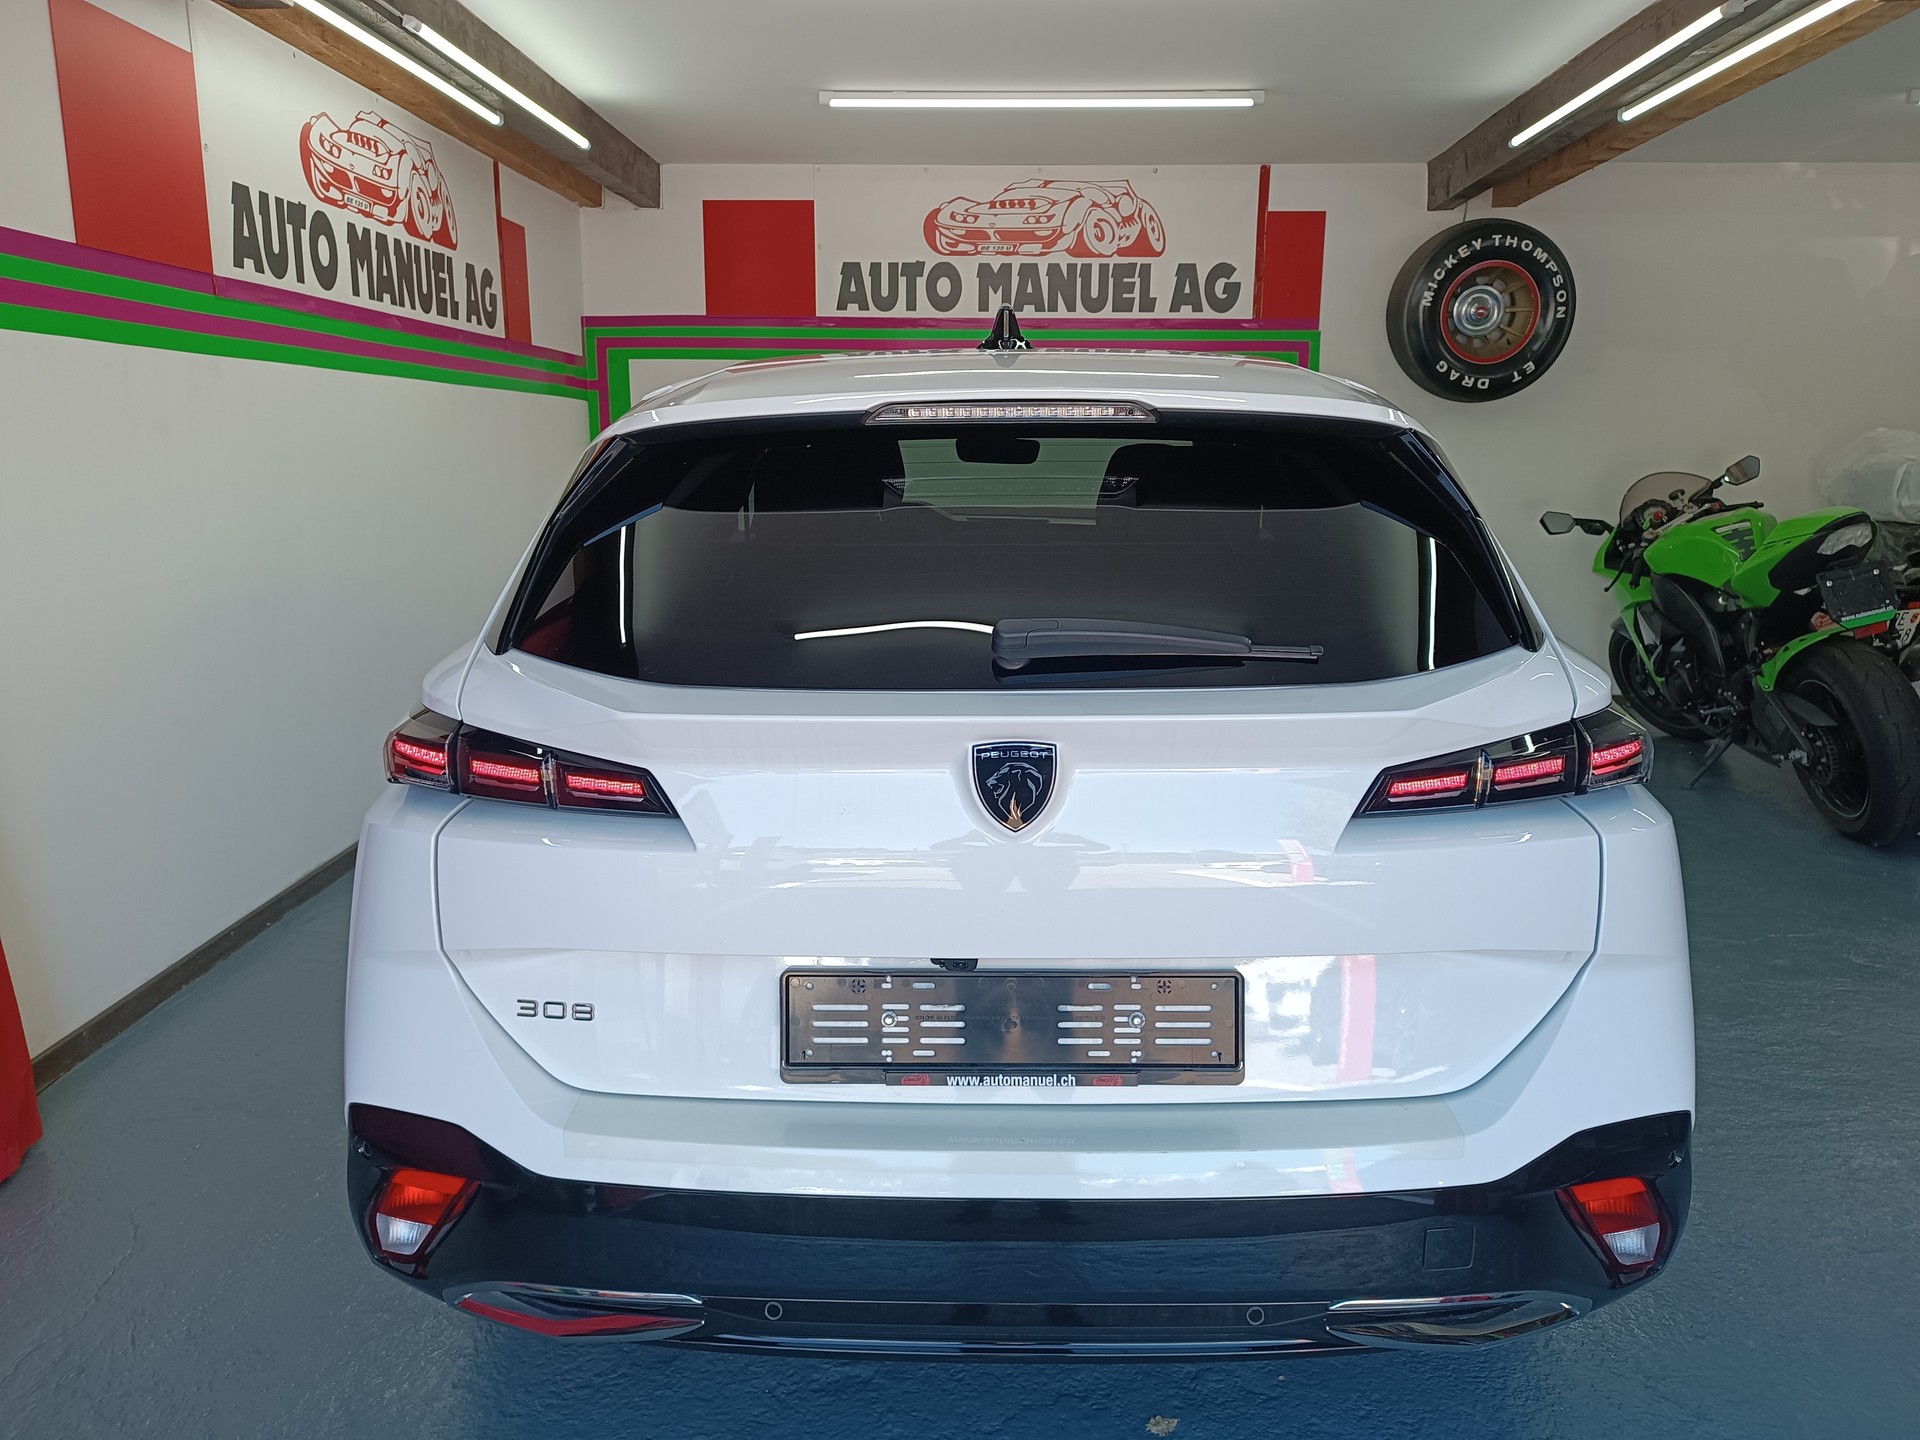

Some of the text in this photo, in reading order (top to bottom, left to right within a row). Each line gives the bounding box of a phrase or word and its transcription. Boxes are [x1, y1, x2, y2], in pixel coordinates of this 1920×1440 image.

[231, 181, 497, 330] AUTO MANUEL AG
[836, 260, 1242, 314] AUTO MANUEL AG
[1421, 234, 1568, 319] MICKEY THOMPSON
[1436, 360, 1536, 390] ET DRAG
[981, 750, 1048, 760] PEUGEOT
[517, 999, 595, 1021] 308
[946, 1074, 1076, 1087] www.automanuel.ch
